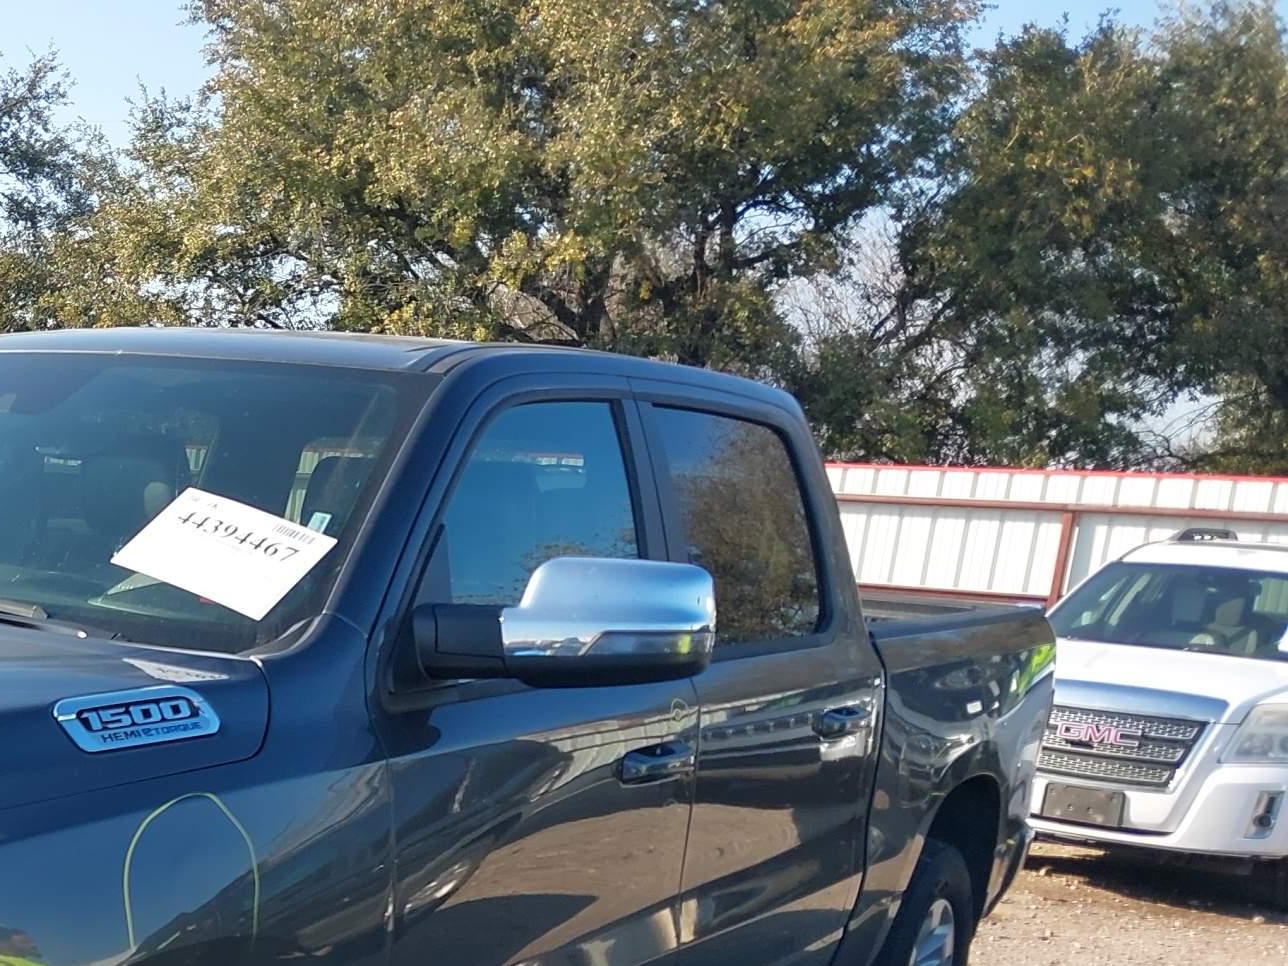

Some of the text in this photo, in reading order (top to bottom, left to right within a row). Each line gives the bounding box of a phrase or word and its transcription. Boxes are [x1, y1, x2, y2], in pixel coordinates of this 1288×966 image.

[177, 511, 300, 562] 44394467
[80, 700, 191, 731] 1500
[101, 730, 141, 744] HEMI
[1056, 721, 1142, 747] GMC
